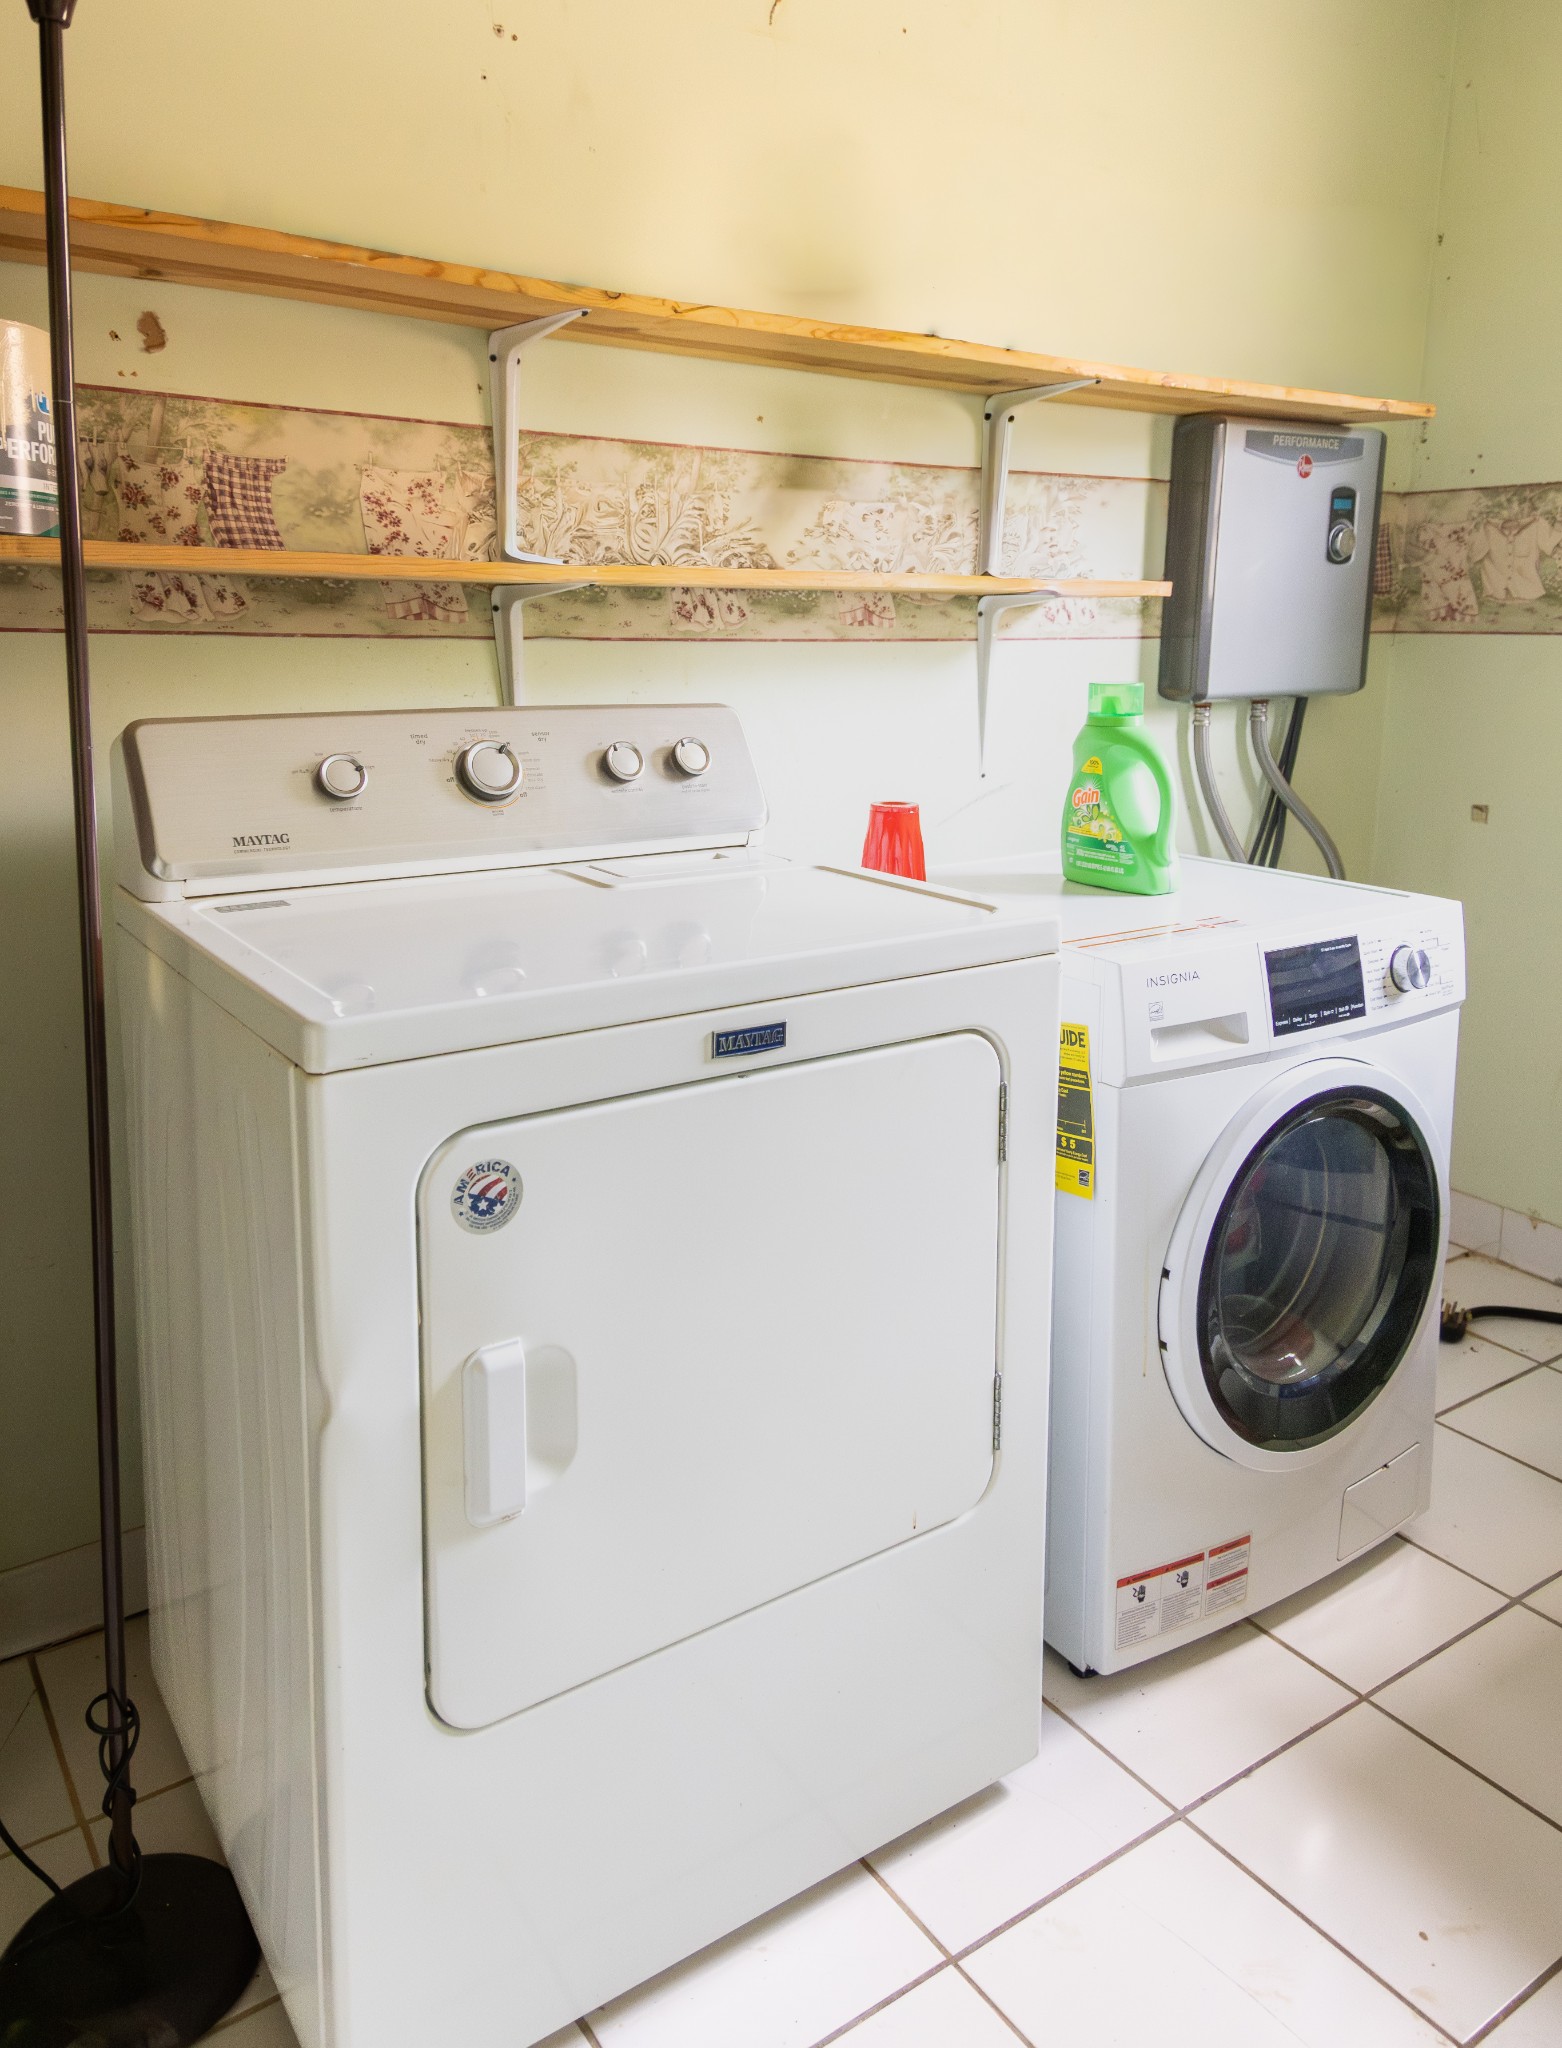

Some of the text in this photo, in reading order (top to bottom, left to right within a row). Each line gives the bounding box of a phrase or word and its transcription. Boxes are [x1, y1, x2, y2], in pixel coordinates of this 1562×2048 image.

[1273, 434, 1339, 450] PERFORMANCE
[1072, 787, 1100, 809] Gain
[232, 833, 290, 848] MAYTAG
[1146, 970, 1201, 988] INSIGNIA
[719, 1027, 784, 1053] MAYTAG
[1069, 1140, 1076, 1149] 5
[453, 1161, 511, 1206] AMERICA
